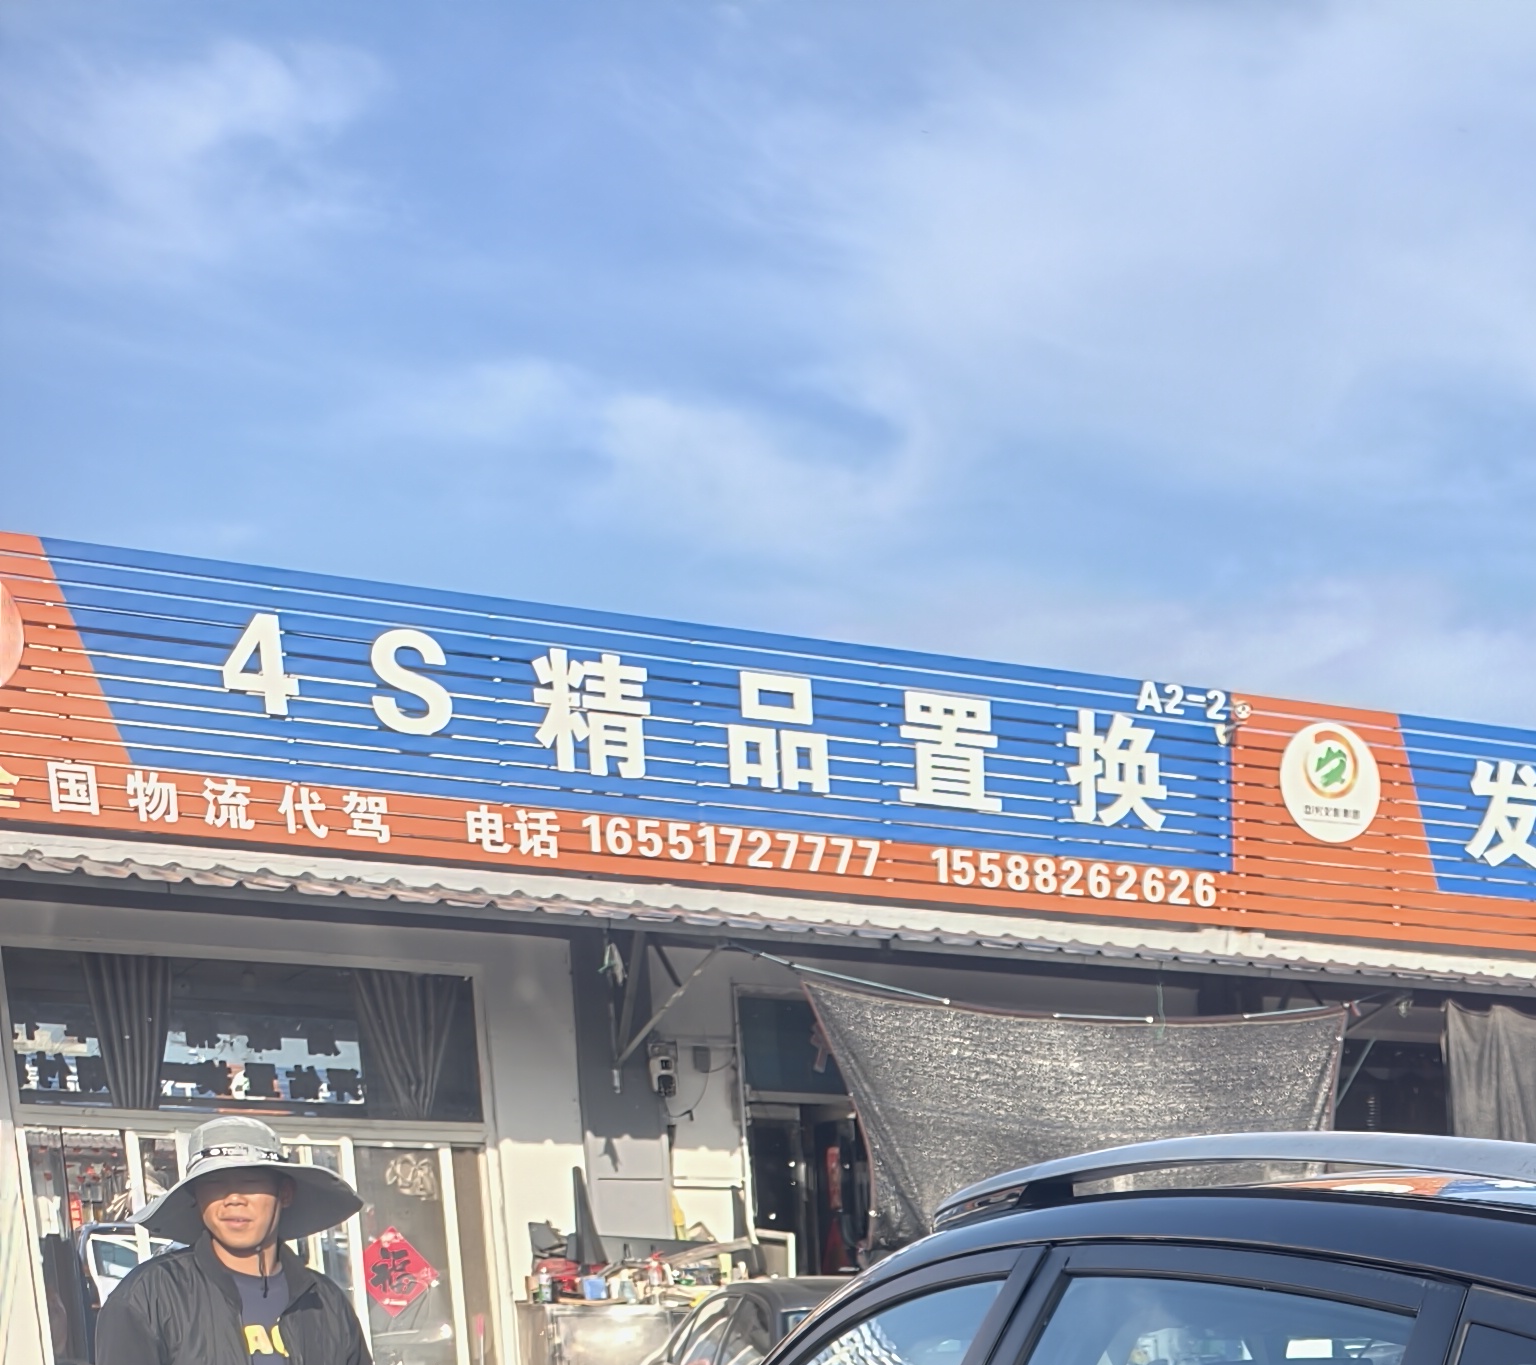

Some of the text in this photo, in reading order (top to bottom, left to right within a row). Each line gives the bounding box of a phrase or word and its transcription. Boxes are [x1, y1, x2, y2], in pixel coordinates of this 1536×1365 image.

[1136, 681, 1227, 721] A2-2
[466, 803, 562, 860] 电话
[581, 814, 881, 877] 16551727777
[931, 847, 1217, 908] 15588262626
[370, 1247, 418, 1295] 福
